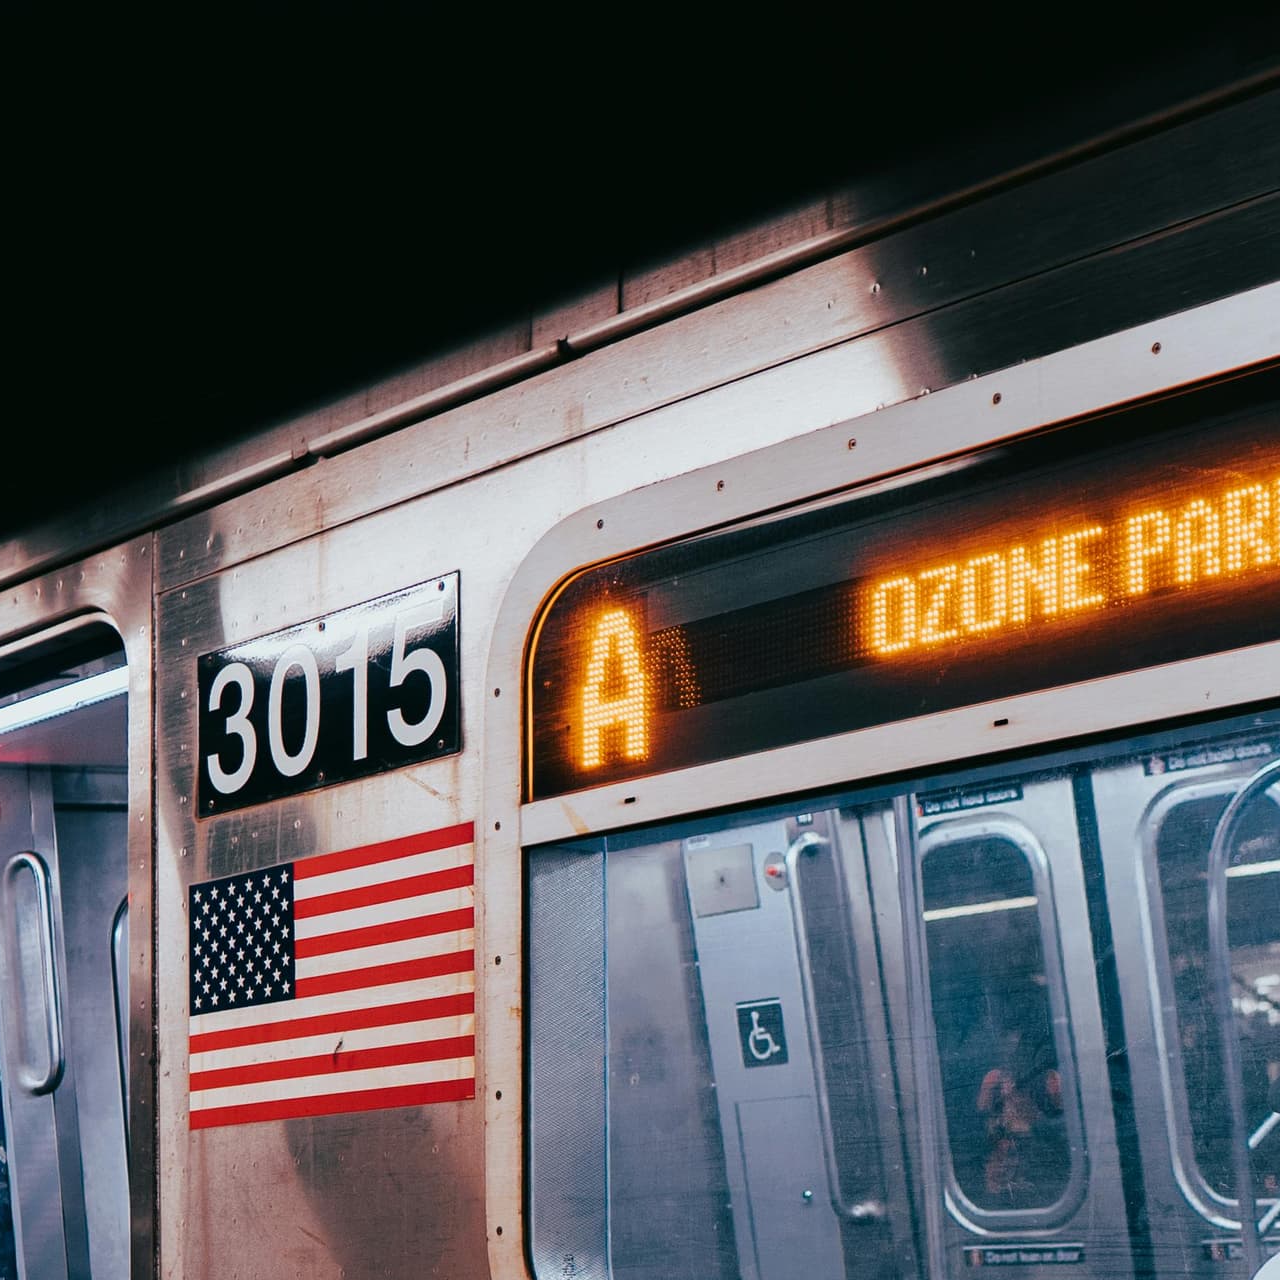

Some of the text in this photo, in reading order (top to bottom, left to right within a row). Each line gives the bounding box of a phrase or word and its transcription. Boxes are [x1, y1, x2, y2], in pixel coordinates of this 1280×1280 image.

[873, 525, 1105, 654] OZONE
[206, 598, 448, 795] 3015
[583, 610, 645, 768] A
